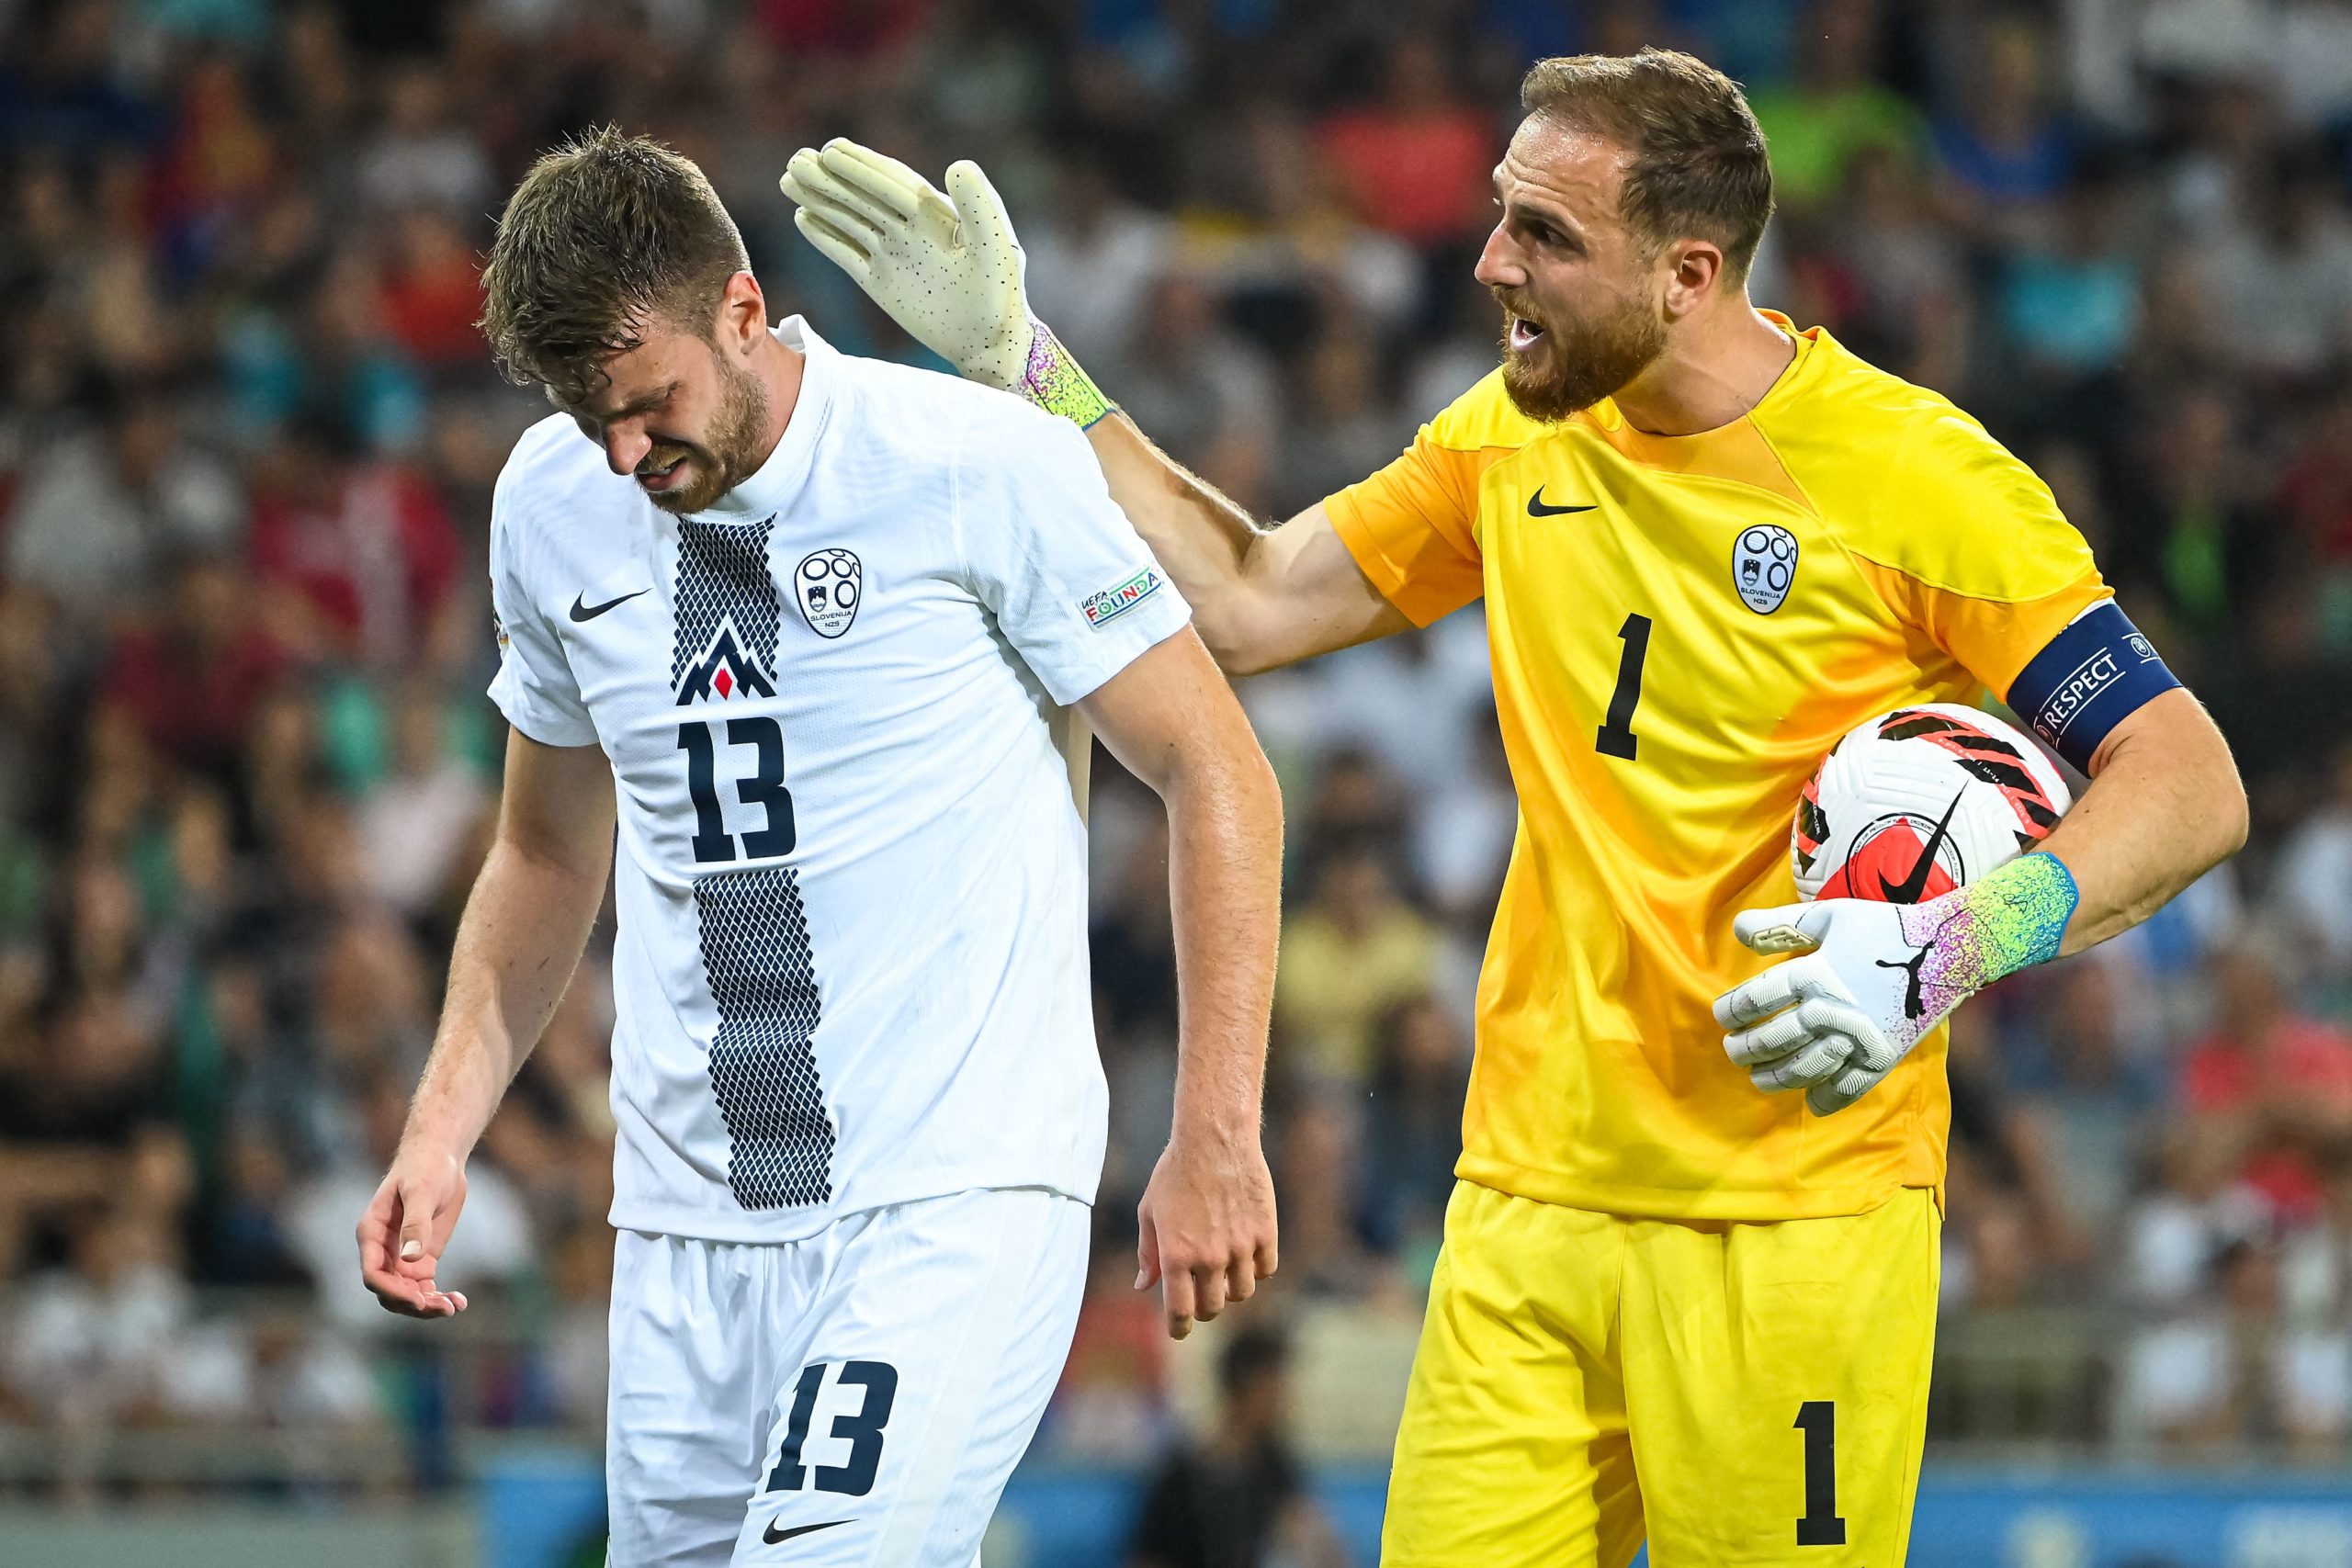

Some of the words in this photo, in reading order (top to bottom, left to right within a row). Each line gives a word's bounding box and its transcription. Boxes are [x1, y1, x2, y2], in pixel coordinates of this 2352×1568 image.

[810, 611, 853, 622] SLOVENIJA
[1081, 591, 1108, 609] UEFA
[1740, 587, 1781, 599] SLOVENIJA
[1595, 613, 1652, 761] 1
[2044, 653, 2118, 729] RESPECT
[677, 716, 797, 863] 13
[764, 1360, 899, 1497] 13
[1792, 1401, 1846, 1546] 1
